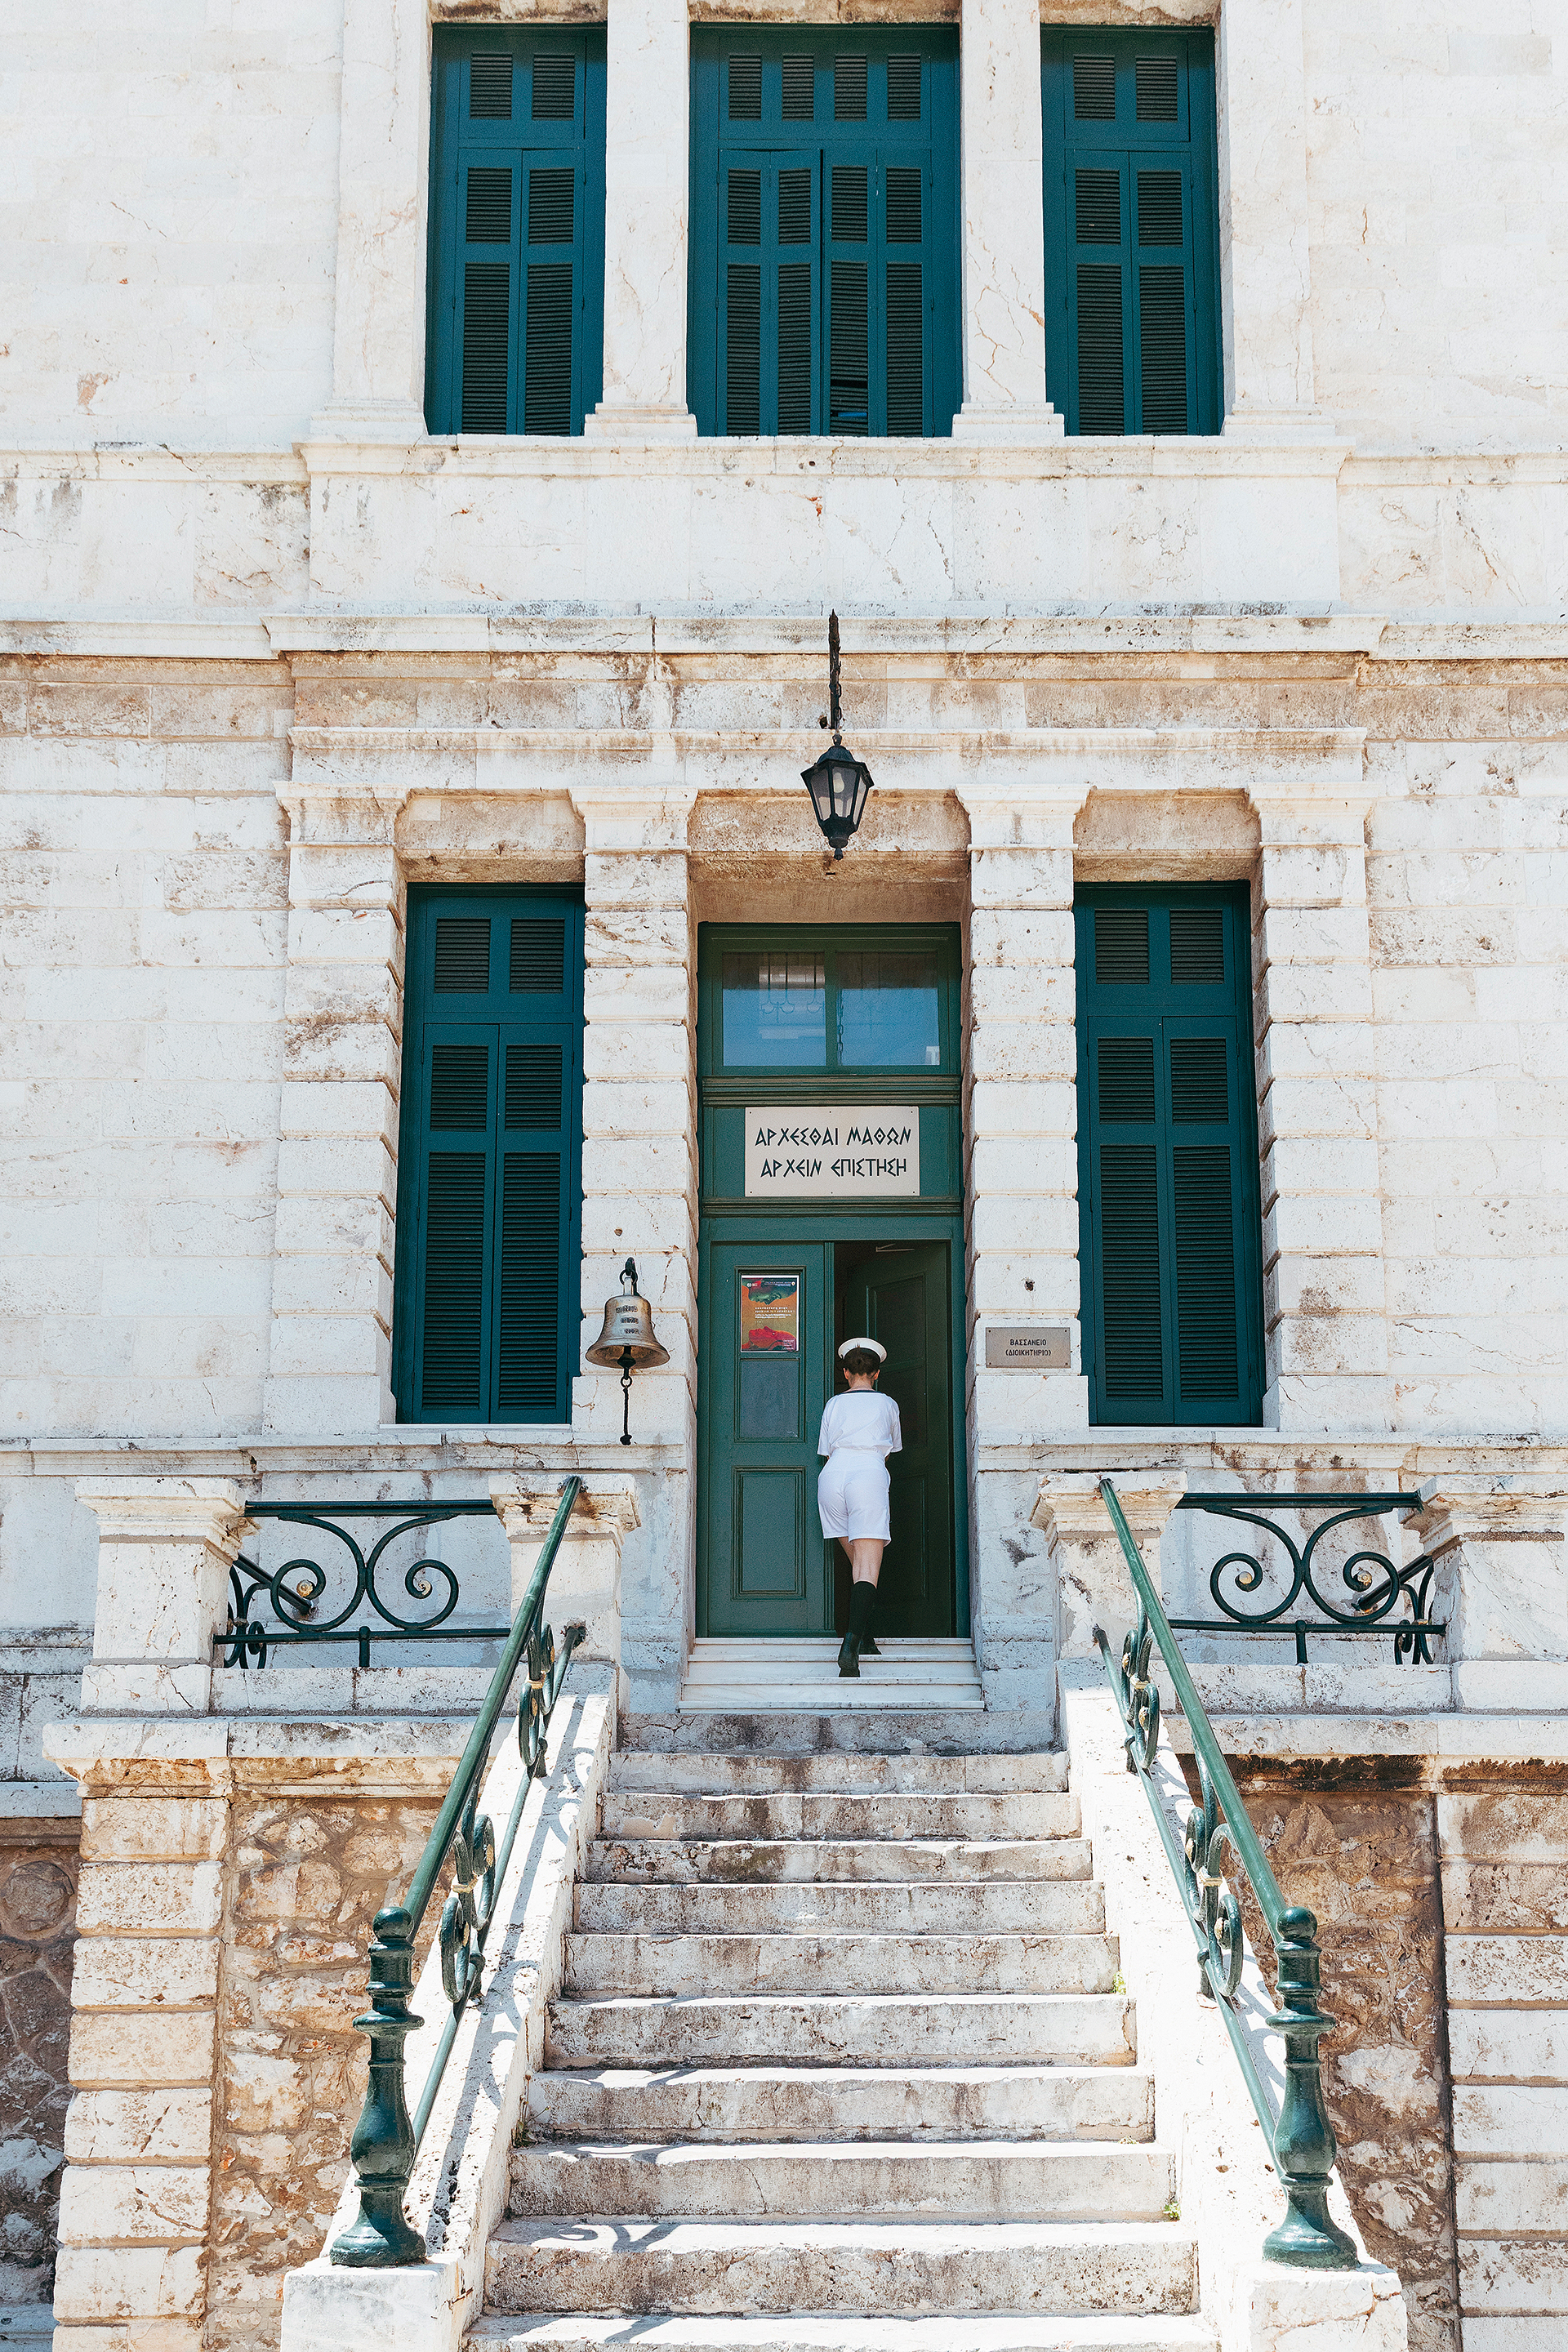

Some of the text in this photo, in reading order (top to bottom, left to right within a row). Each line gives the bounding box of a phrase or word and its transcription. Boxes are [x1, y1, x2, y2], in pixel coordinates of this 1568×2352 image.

[755, 1125, 911, 1147] ΑΡΧΕΣΘΑΙ ΜΑΘΩΝ
[760, 1157, 906, 1178] ΑΡΧΕΙΝ ΕΠΙΣΤΗΣΗ
